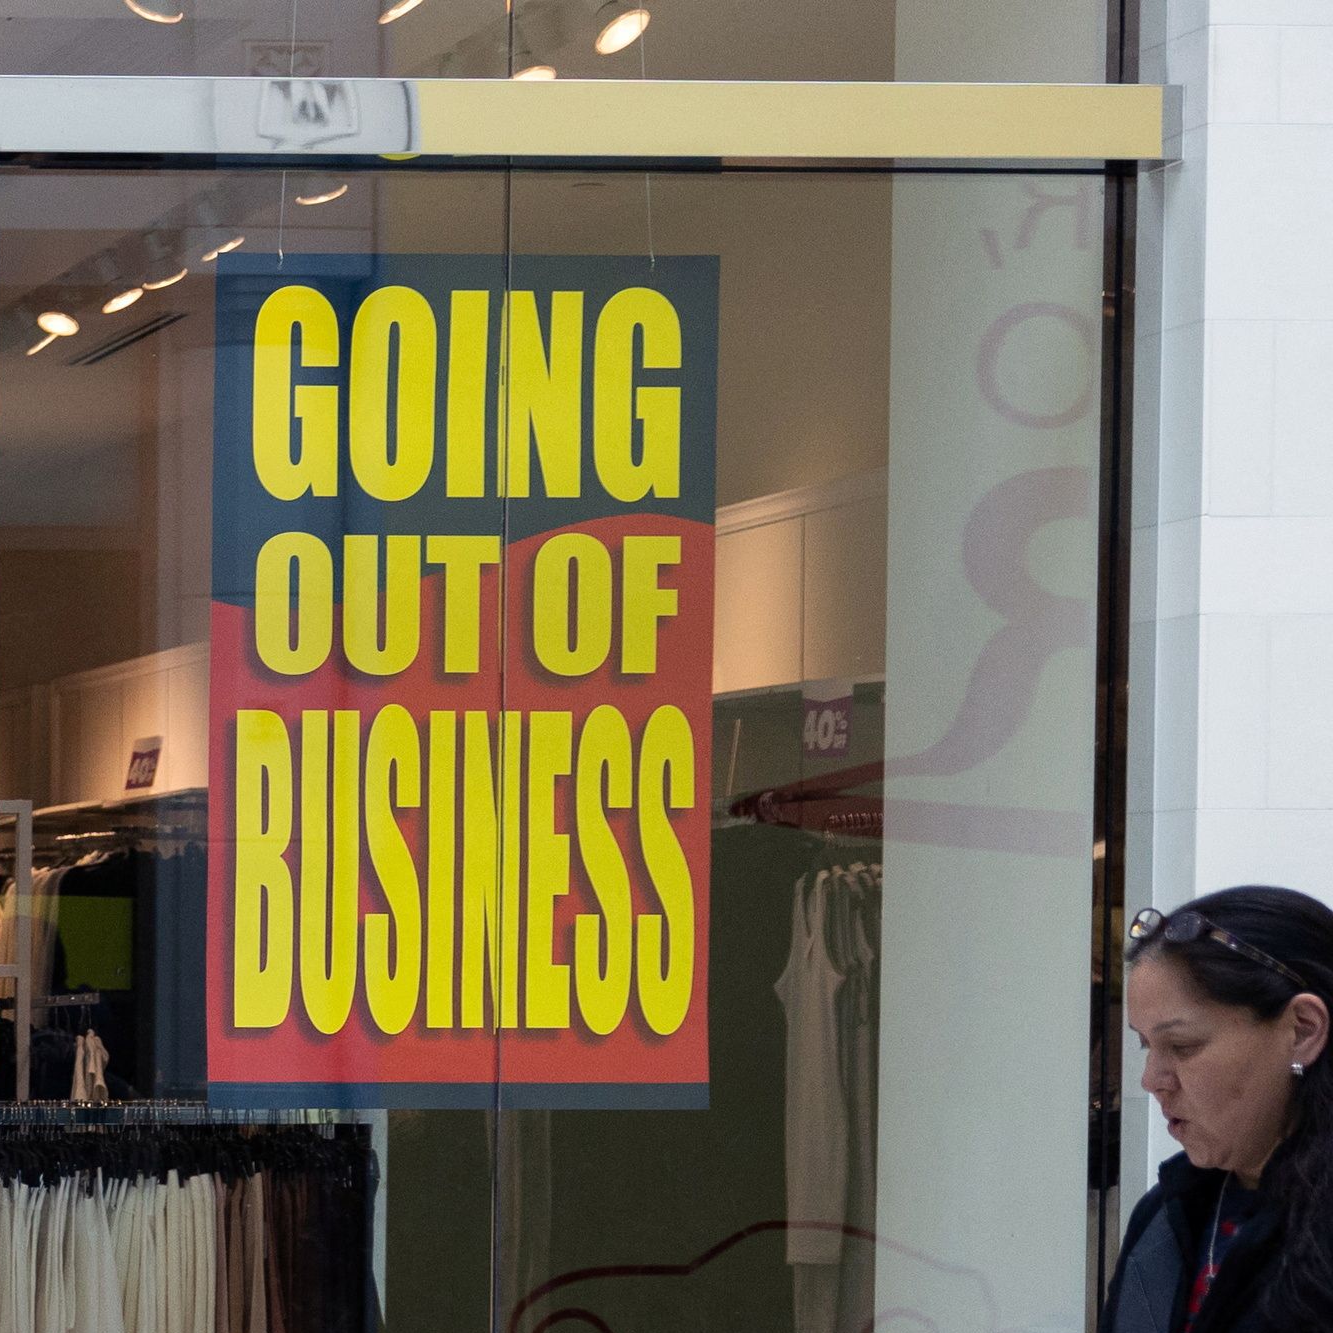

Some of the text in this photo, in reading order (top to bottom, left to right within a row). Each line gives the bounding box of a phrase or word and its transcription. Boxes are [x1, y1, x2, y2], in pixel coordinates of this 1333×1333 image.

[252, 286, 682, 502] GOING
[255, 533, 682, 676] OUT OF
[233, 704, 695, 1035] BUSINESS
